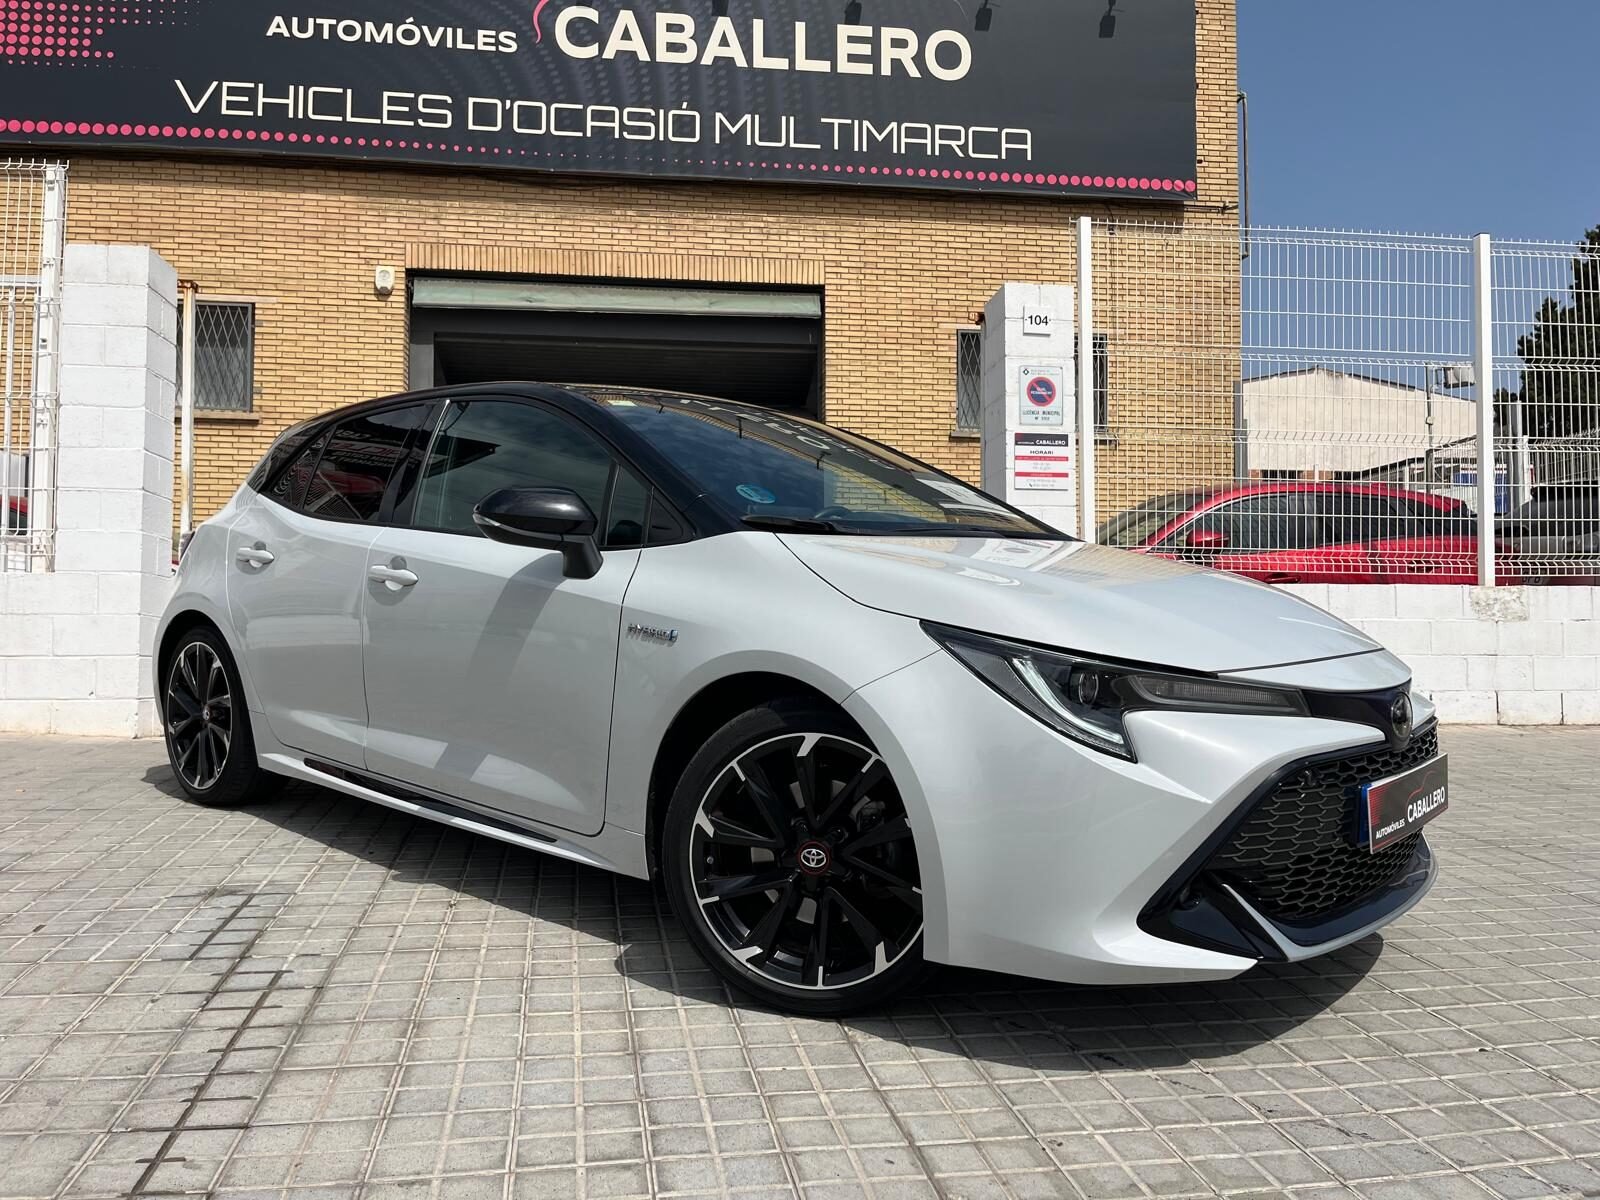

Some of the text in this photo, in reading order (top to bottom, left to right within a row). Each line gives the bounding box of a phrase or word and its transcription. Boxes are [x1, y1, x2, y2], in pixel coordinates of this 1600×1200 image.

[266, 5, 972, 81] AUTOMÓVILES CABALLERO
[174, 79, 1033, 161] VEHICLES D'OCASIÓ MULTIMARCA
[1027, 314, 1049, 326] 104
[1375, 785, 1446, 840] AUTOMÓVILES CABALLERO
